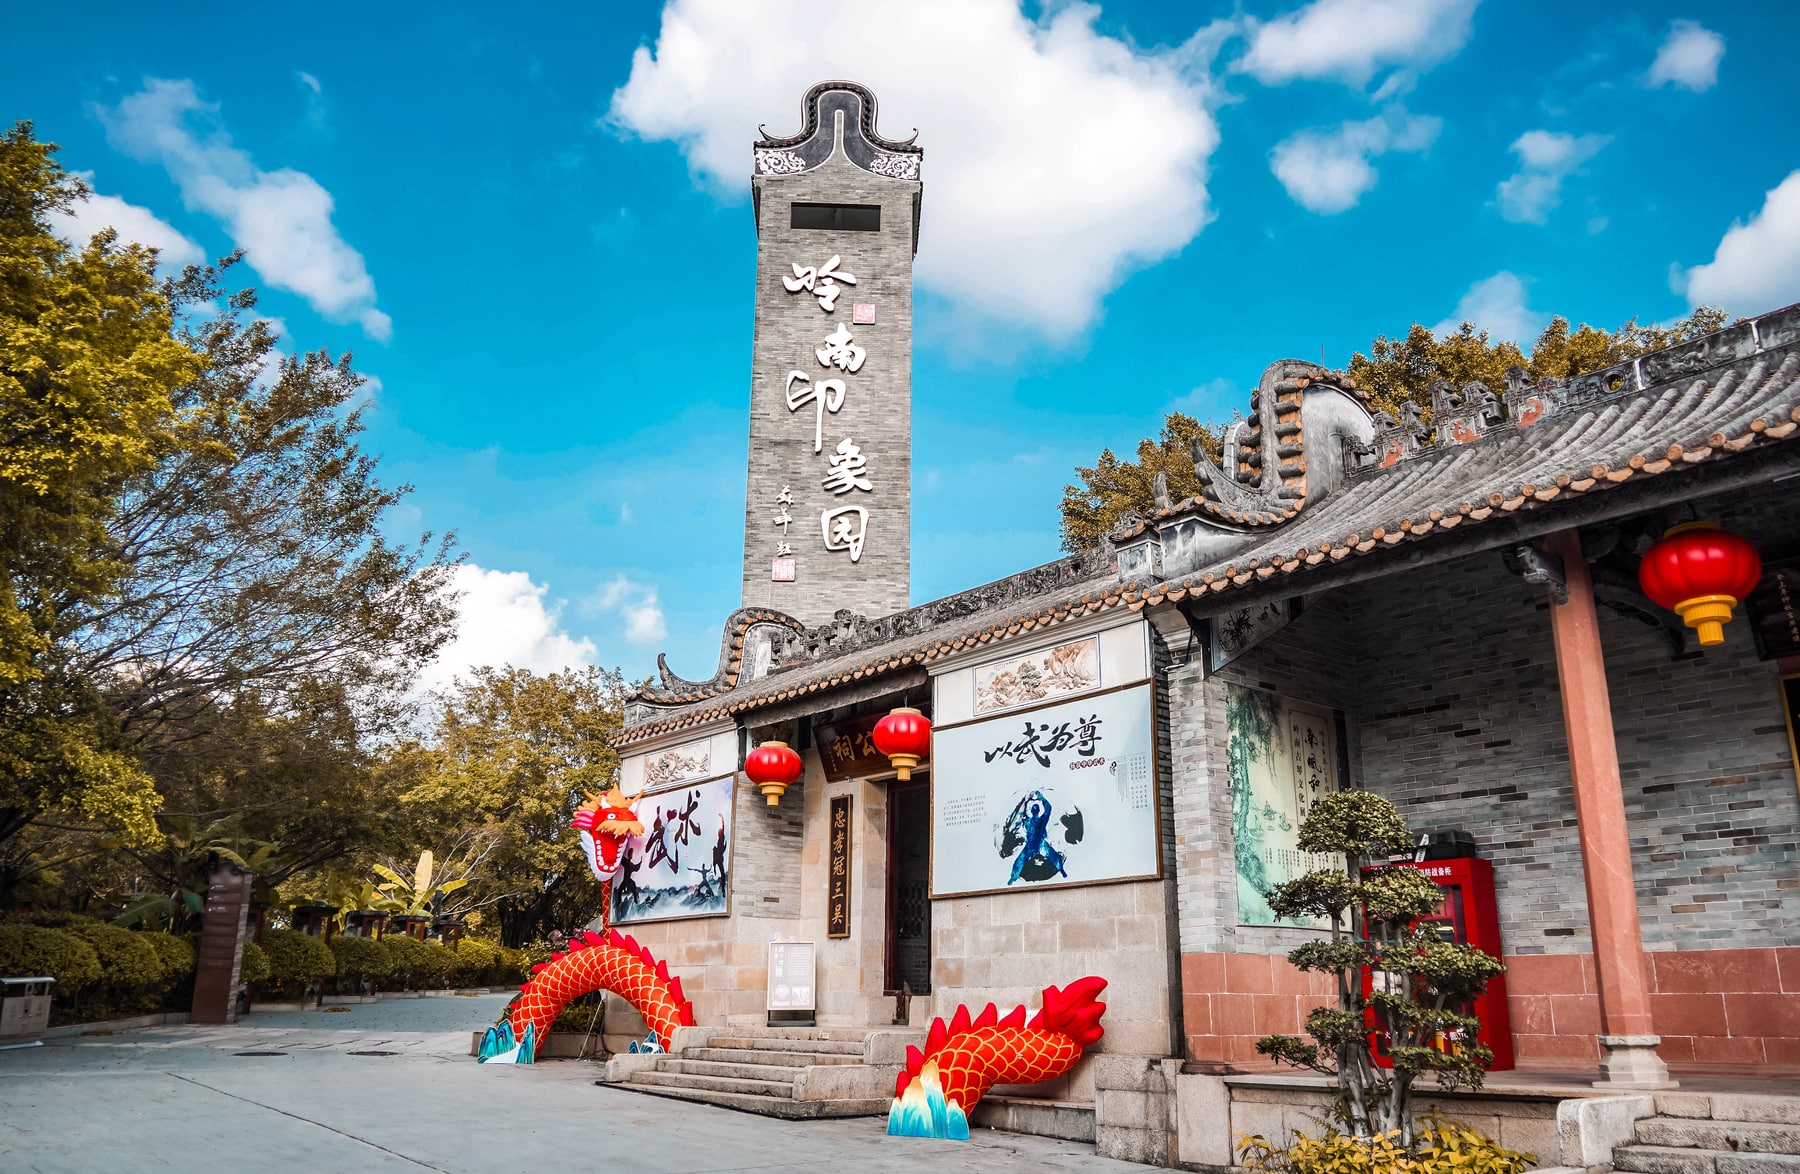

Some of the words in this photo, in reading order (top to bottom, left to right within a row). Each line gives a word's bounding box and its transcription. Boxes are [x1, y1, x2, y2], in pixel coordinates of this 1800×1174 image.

[984, 714, 1103, 768] 以武为尊
[645, 789, 702, 875] 武术
